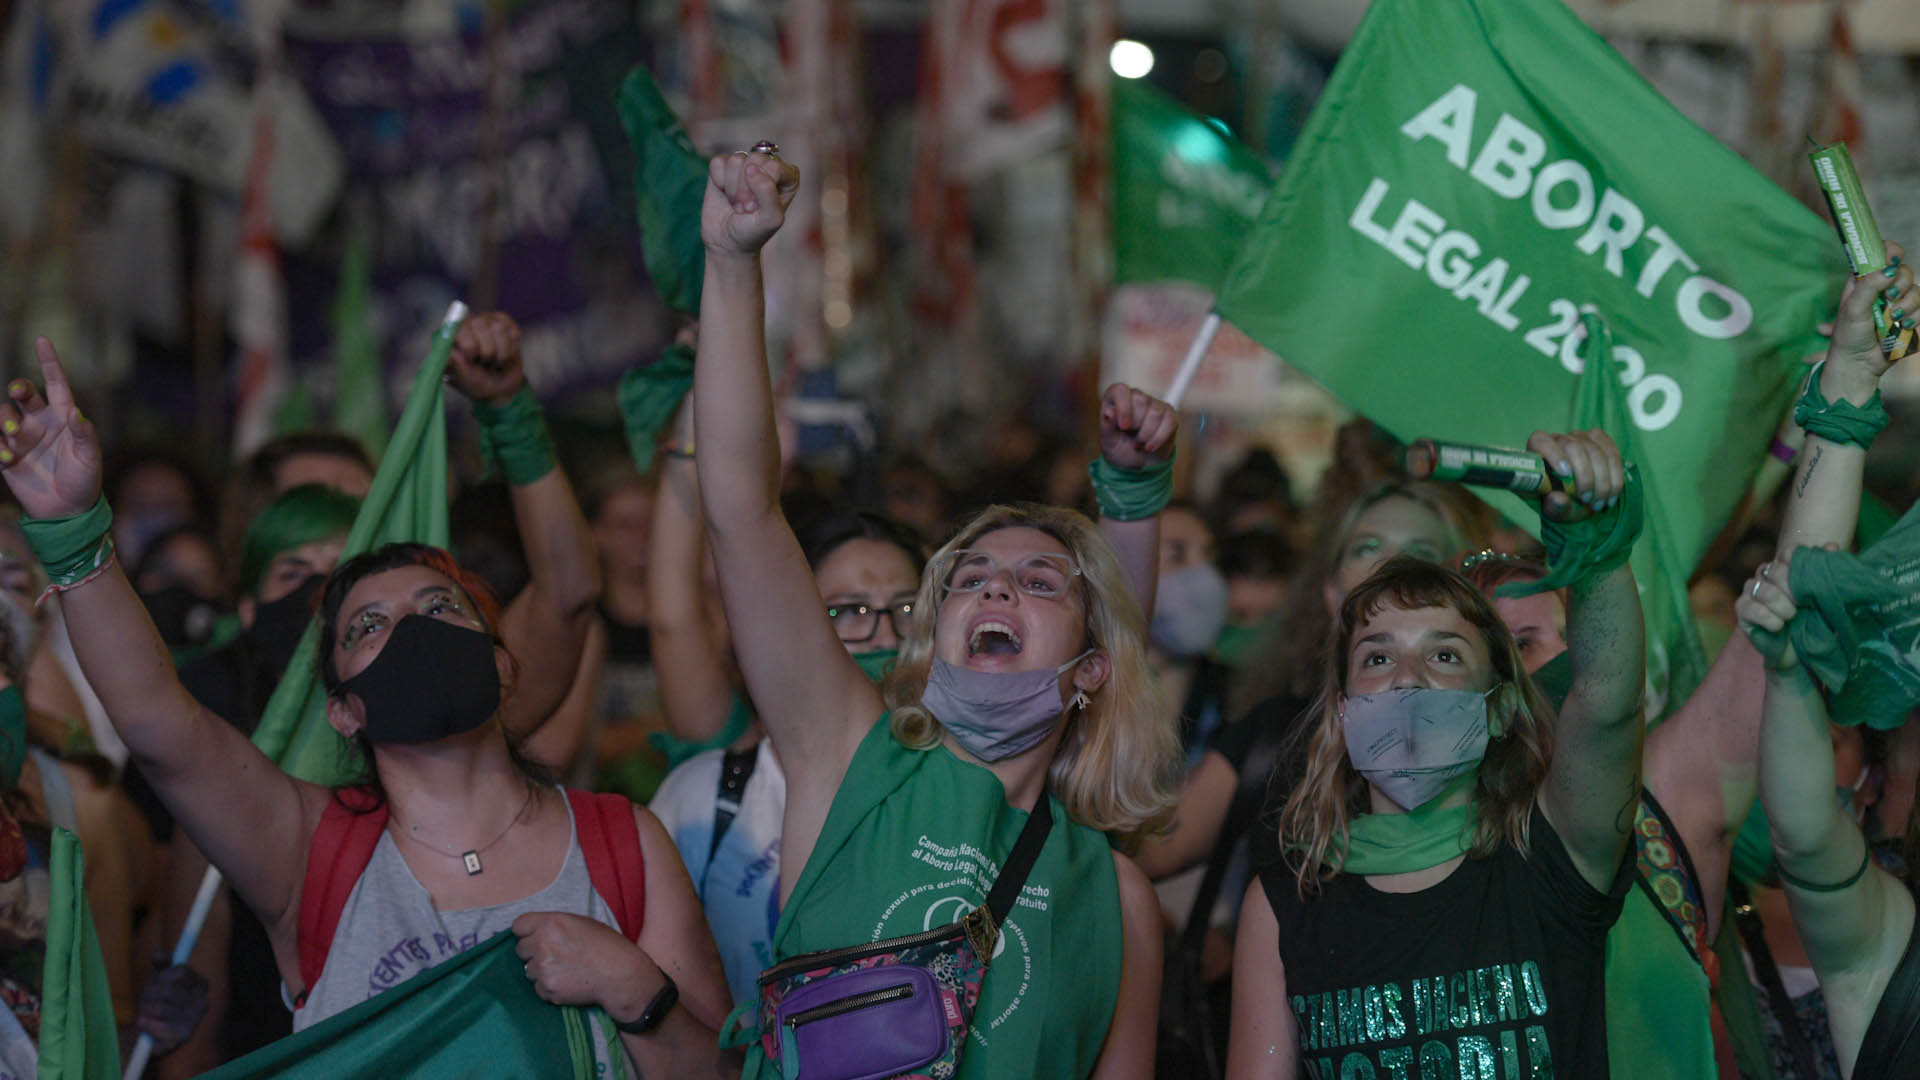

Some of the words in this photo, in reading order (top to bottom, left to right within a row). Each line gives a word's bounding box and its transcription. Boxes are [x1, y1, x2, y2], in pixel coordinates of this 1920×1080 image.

[1819, 156, 1841, 192] HUMO
[1401, 83, 1753, 339] ABORTO
[1833, 192, 1848, 210] DE
[1840, 210, 1868, 265] BENGALA
[1349, 177, 1531, 332] LEGAL
[911, 849, 922, 860] al
[921, 852, 953, 872] Aborto
[959, 843, 991, 870] Nacional
[882, 891, 909, 920] sexual
[910, 884, 935, 897] para
[1015, 896, 1048, 912] ratuito
[1021, 885, 1050, 897] recho
[1023, 955, 1032, 981] para
[1018, 982, 1029, 996] no
[990, 996, 1021, 1029] abortar
